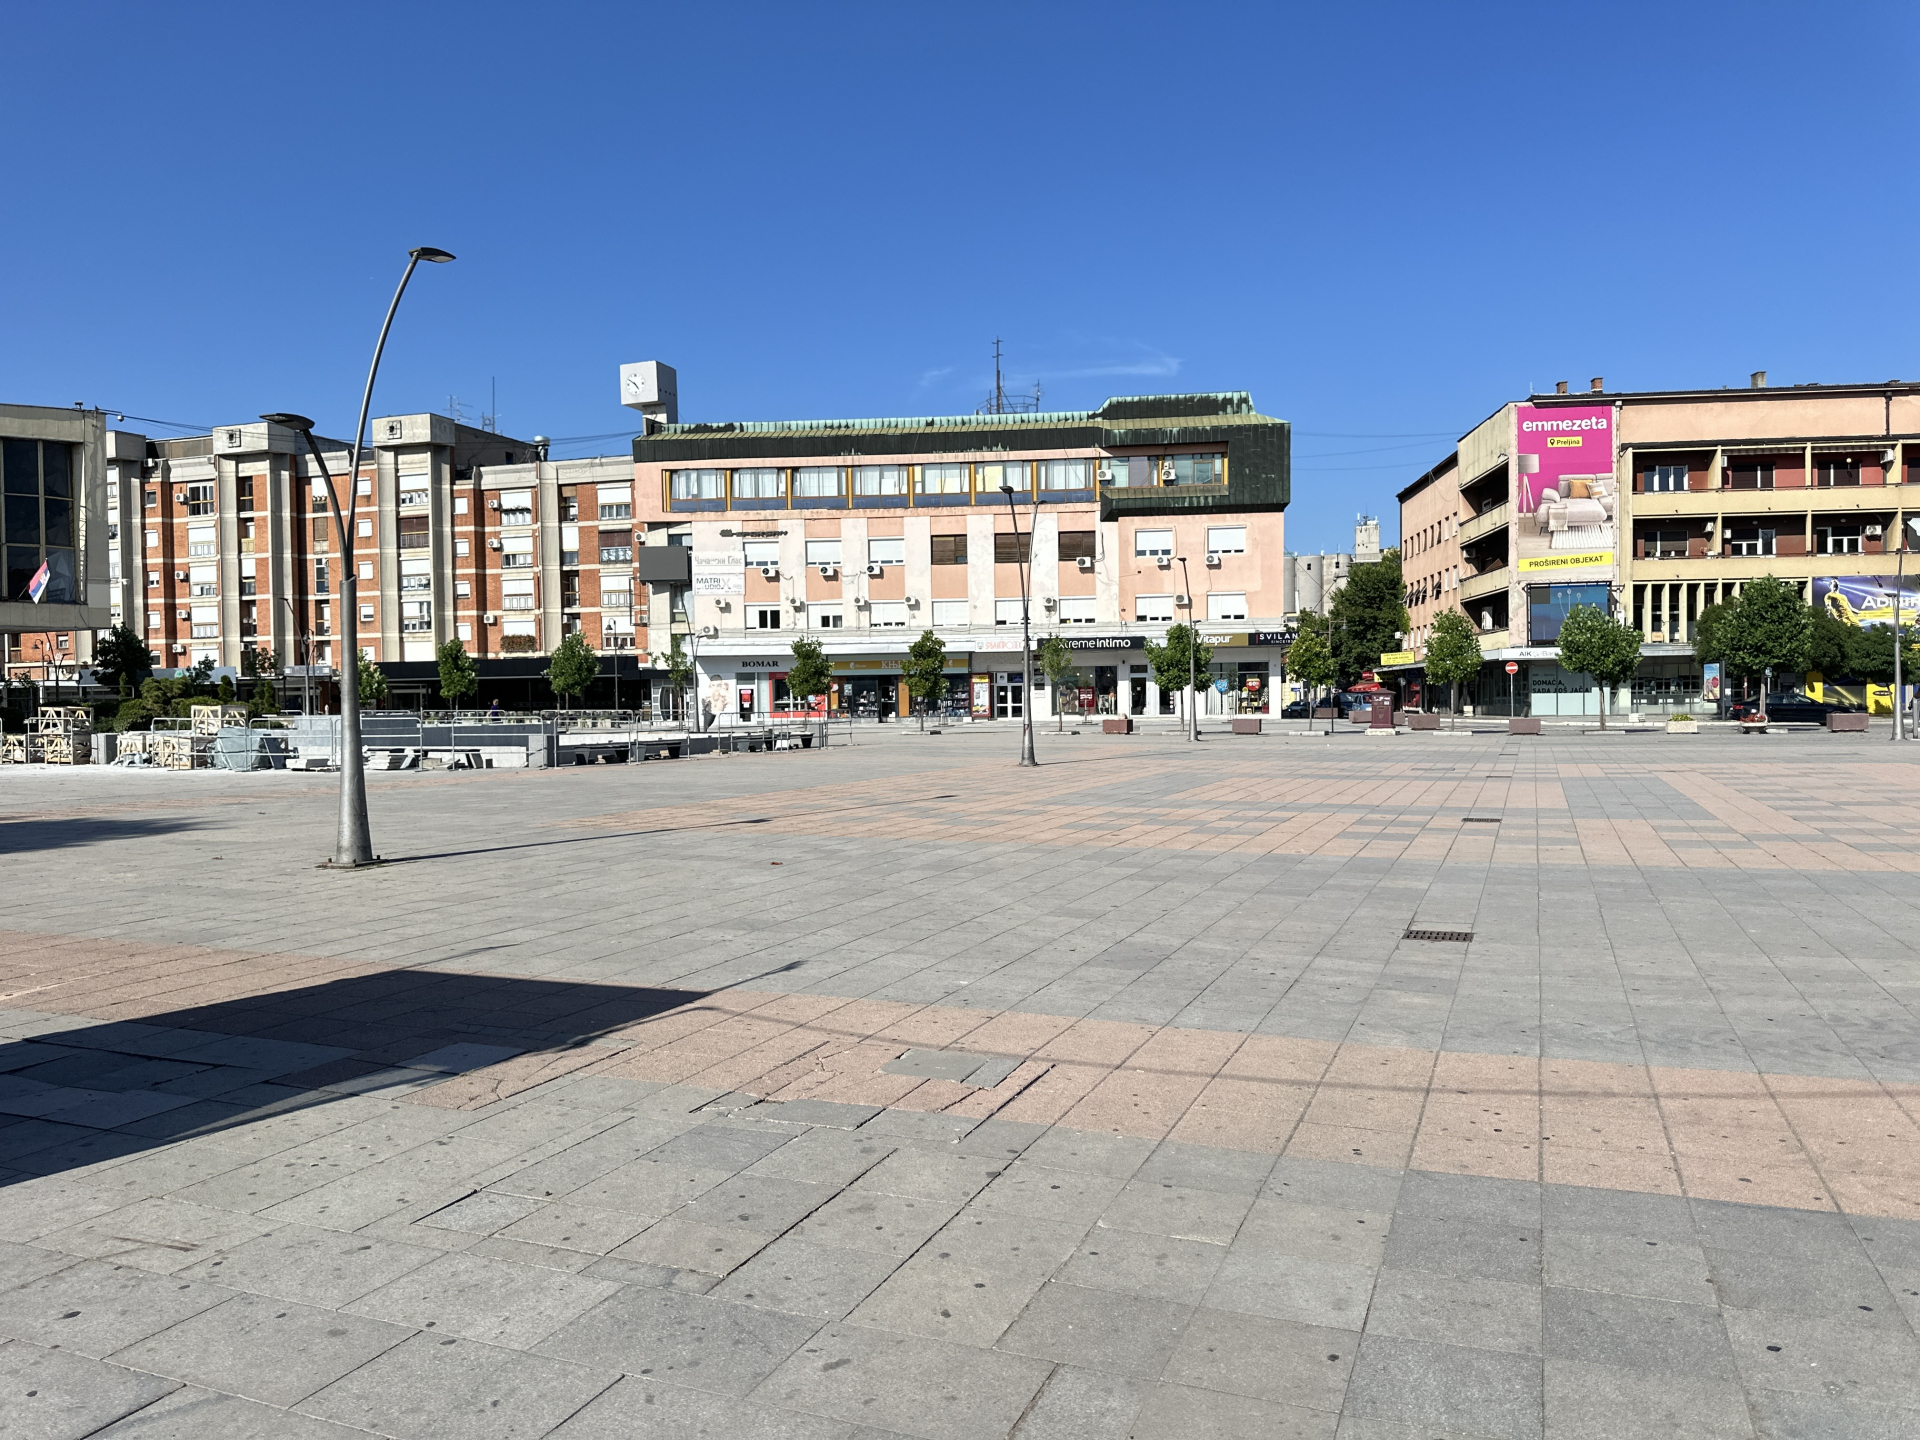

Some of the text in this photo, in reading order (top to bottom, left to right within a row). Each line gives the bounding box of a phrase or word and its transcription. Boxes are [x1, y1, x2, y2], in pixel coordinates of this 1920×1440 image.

[1522, 416, 1607, 432] emmezeta
[727, 555, 742, 565] Глас
[1529, 555, 1604, 568] PROŠIRENI OBJEKAT
[1196, 634, 1233, 646] Vitapur
[1259, 632, 1299, 640] SVILAN
[1058, 638, 1131, 649] xtreme intimo
[741, 660, 779, 668] BOMAR
